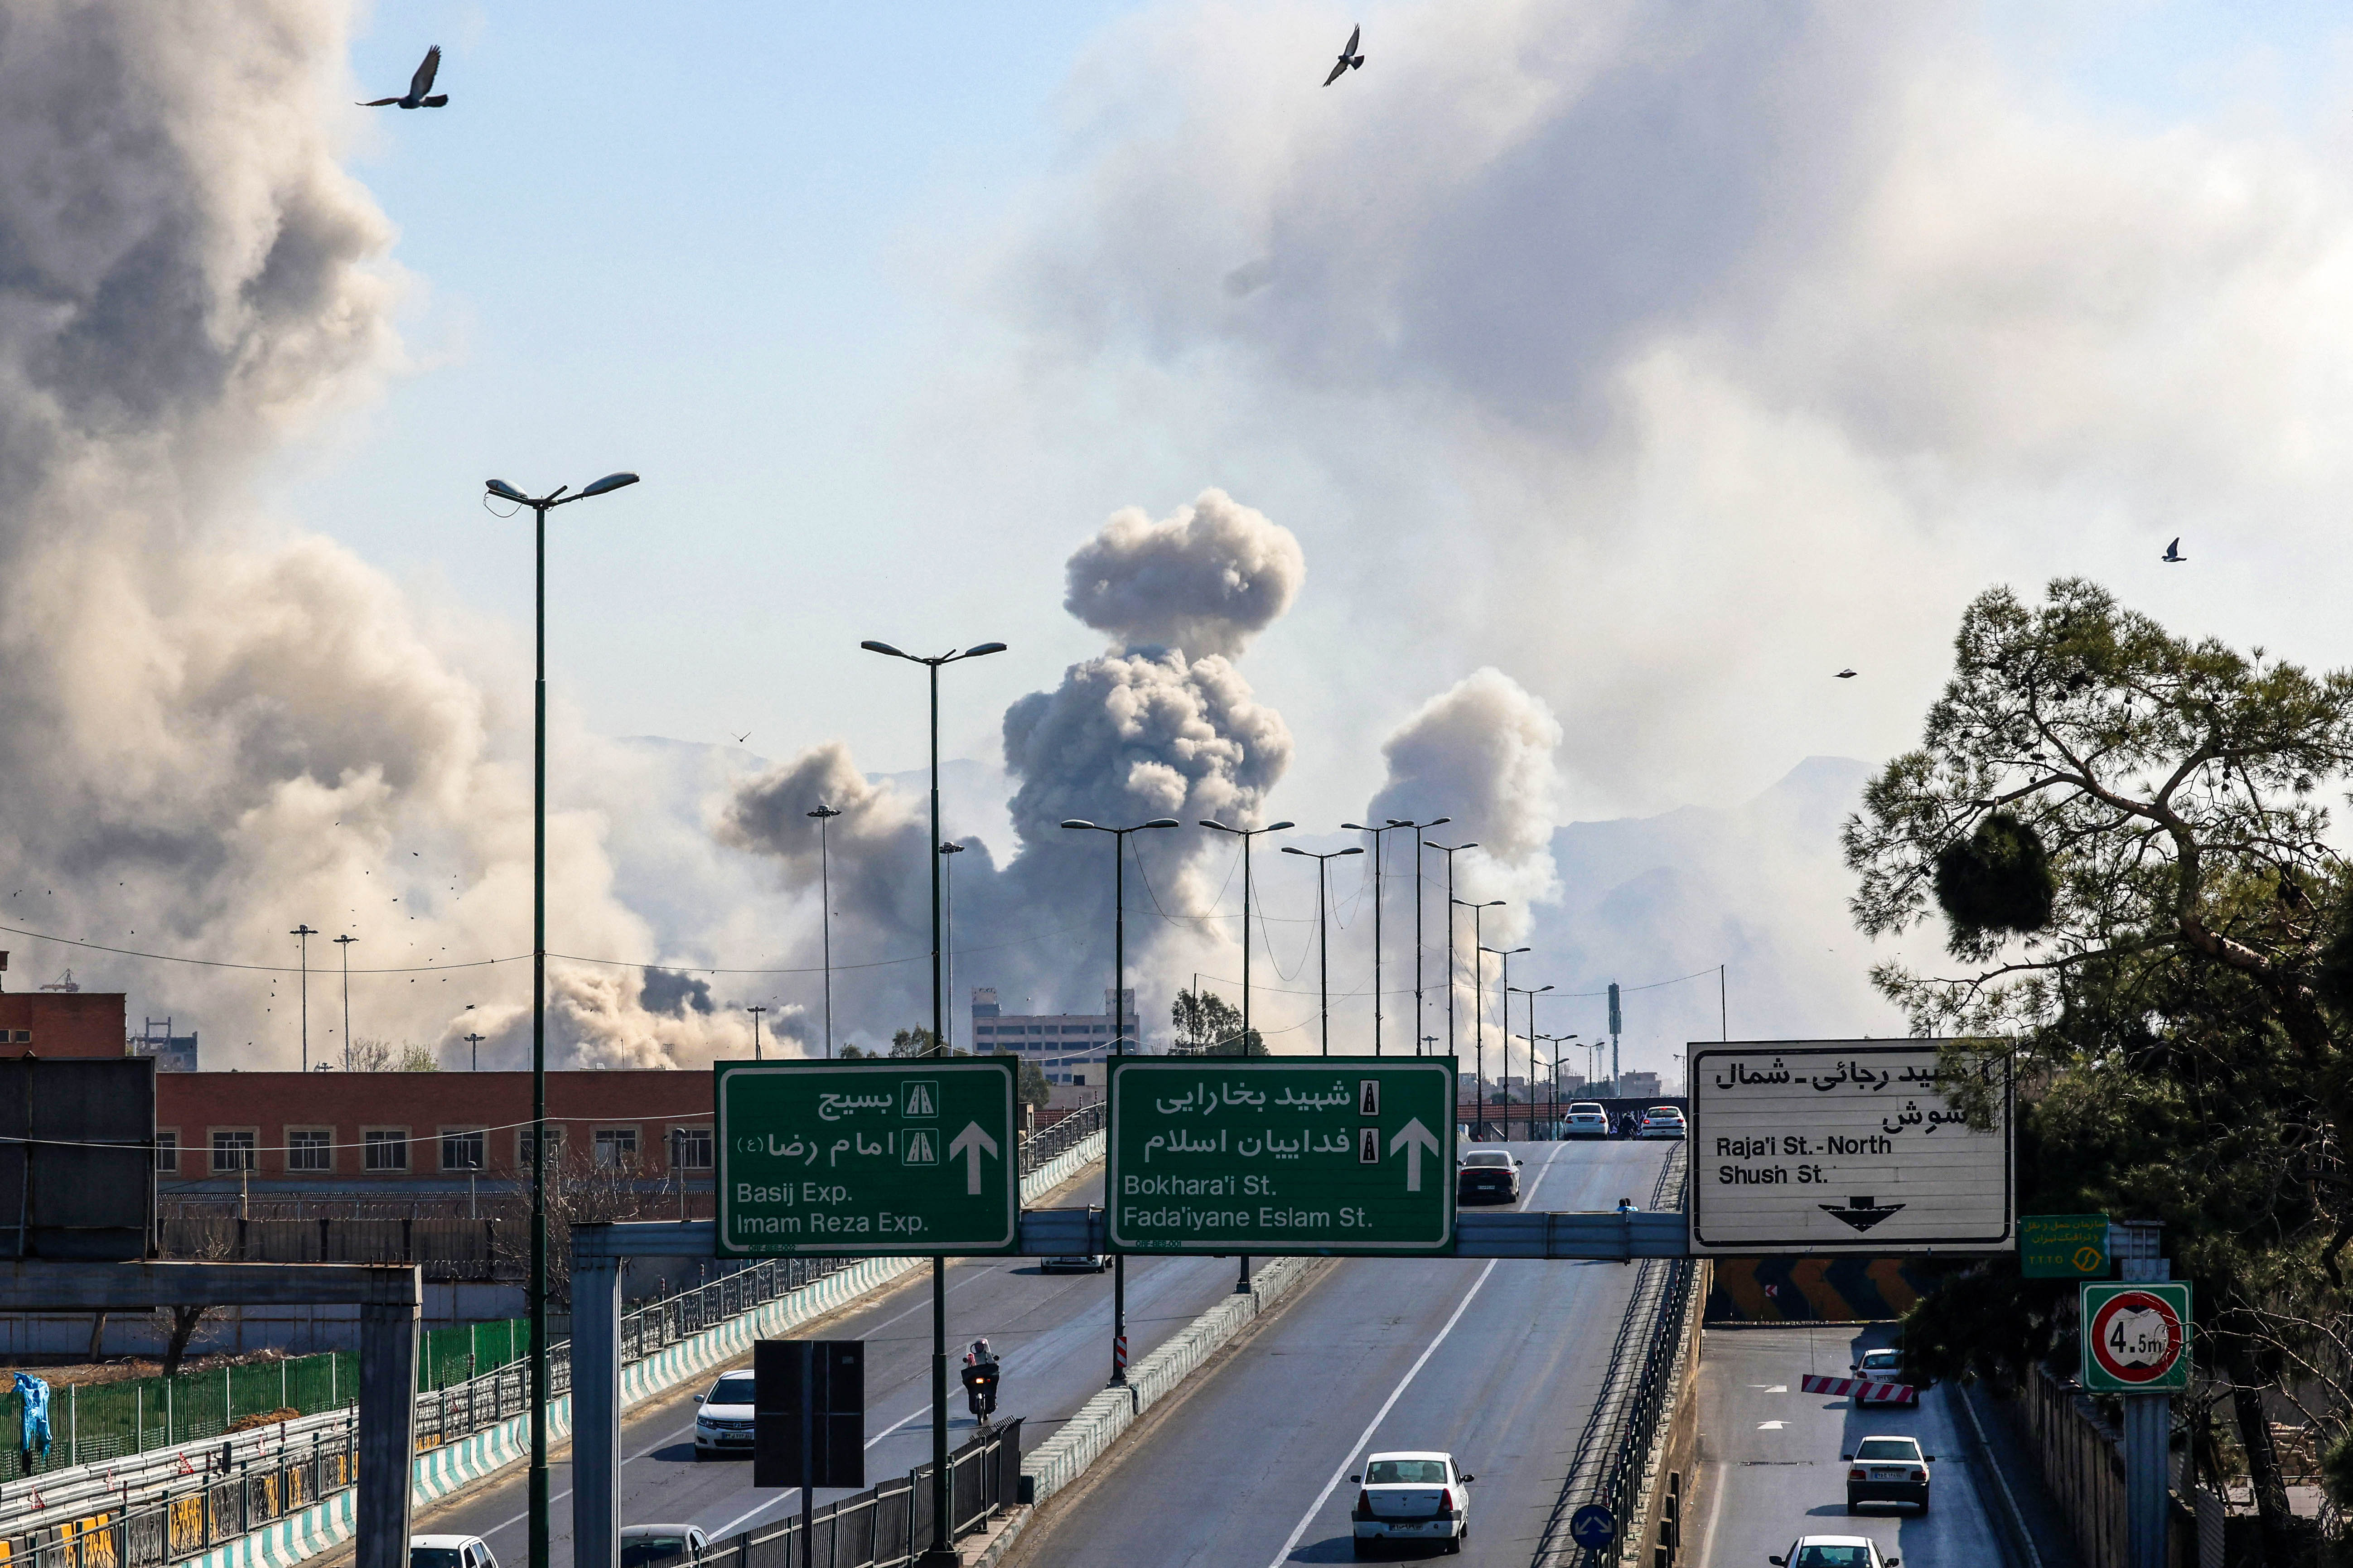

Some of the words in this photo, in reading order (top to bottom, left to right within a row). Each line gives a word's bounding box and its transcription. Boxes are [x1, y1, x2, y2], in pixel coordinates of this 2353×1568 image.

[818, 1093, 893, 1121] بسیج
[1156, 1082, 1266, 1115] بخارایی
[1275, 1080, 1351, 1112] شهید
[768, 1134, 818, 1166] رضا
[830, 1132, 894, 1167] امام
[1145, 1129, 1226, 1163] اسلام
[1238, 1128, 1350, 1159] فداییان
[1717, 1136, 1775, 1160] Raja'i
[1125, 1175, 1235, 1195] Bokhara'i
[1243, 1175, 1276, 1196] St.
[1719, 1165, 1788, 1184] Shush
[1797, 1164, 1828, 1184] St.
[737, 1183, 793, 1206] Basij
[803, 1182, 852, 1206] Exp.
[738, 1214, 801, 1233] Imam
[810, 1213, 870, 1233] Reza
[879, 1212, 928, 1235] Exp.
[1124, 1206, 1250, 1231] Fada'iyane
[1260, 1207, 1330, 1227] Eslam
[1339, 1207, 1372, 1227] St.
